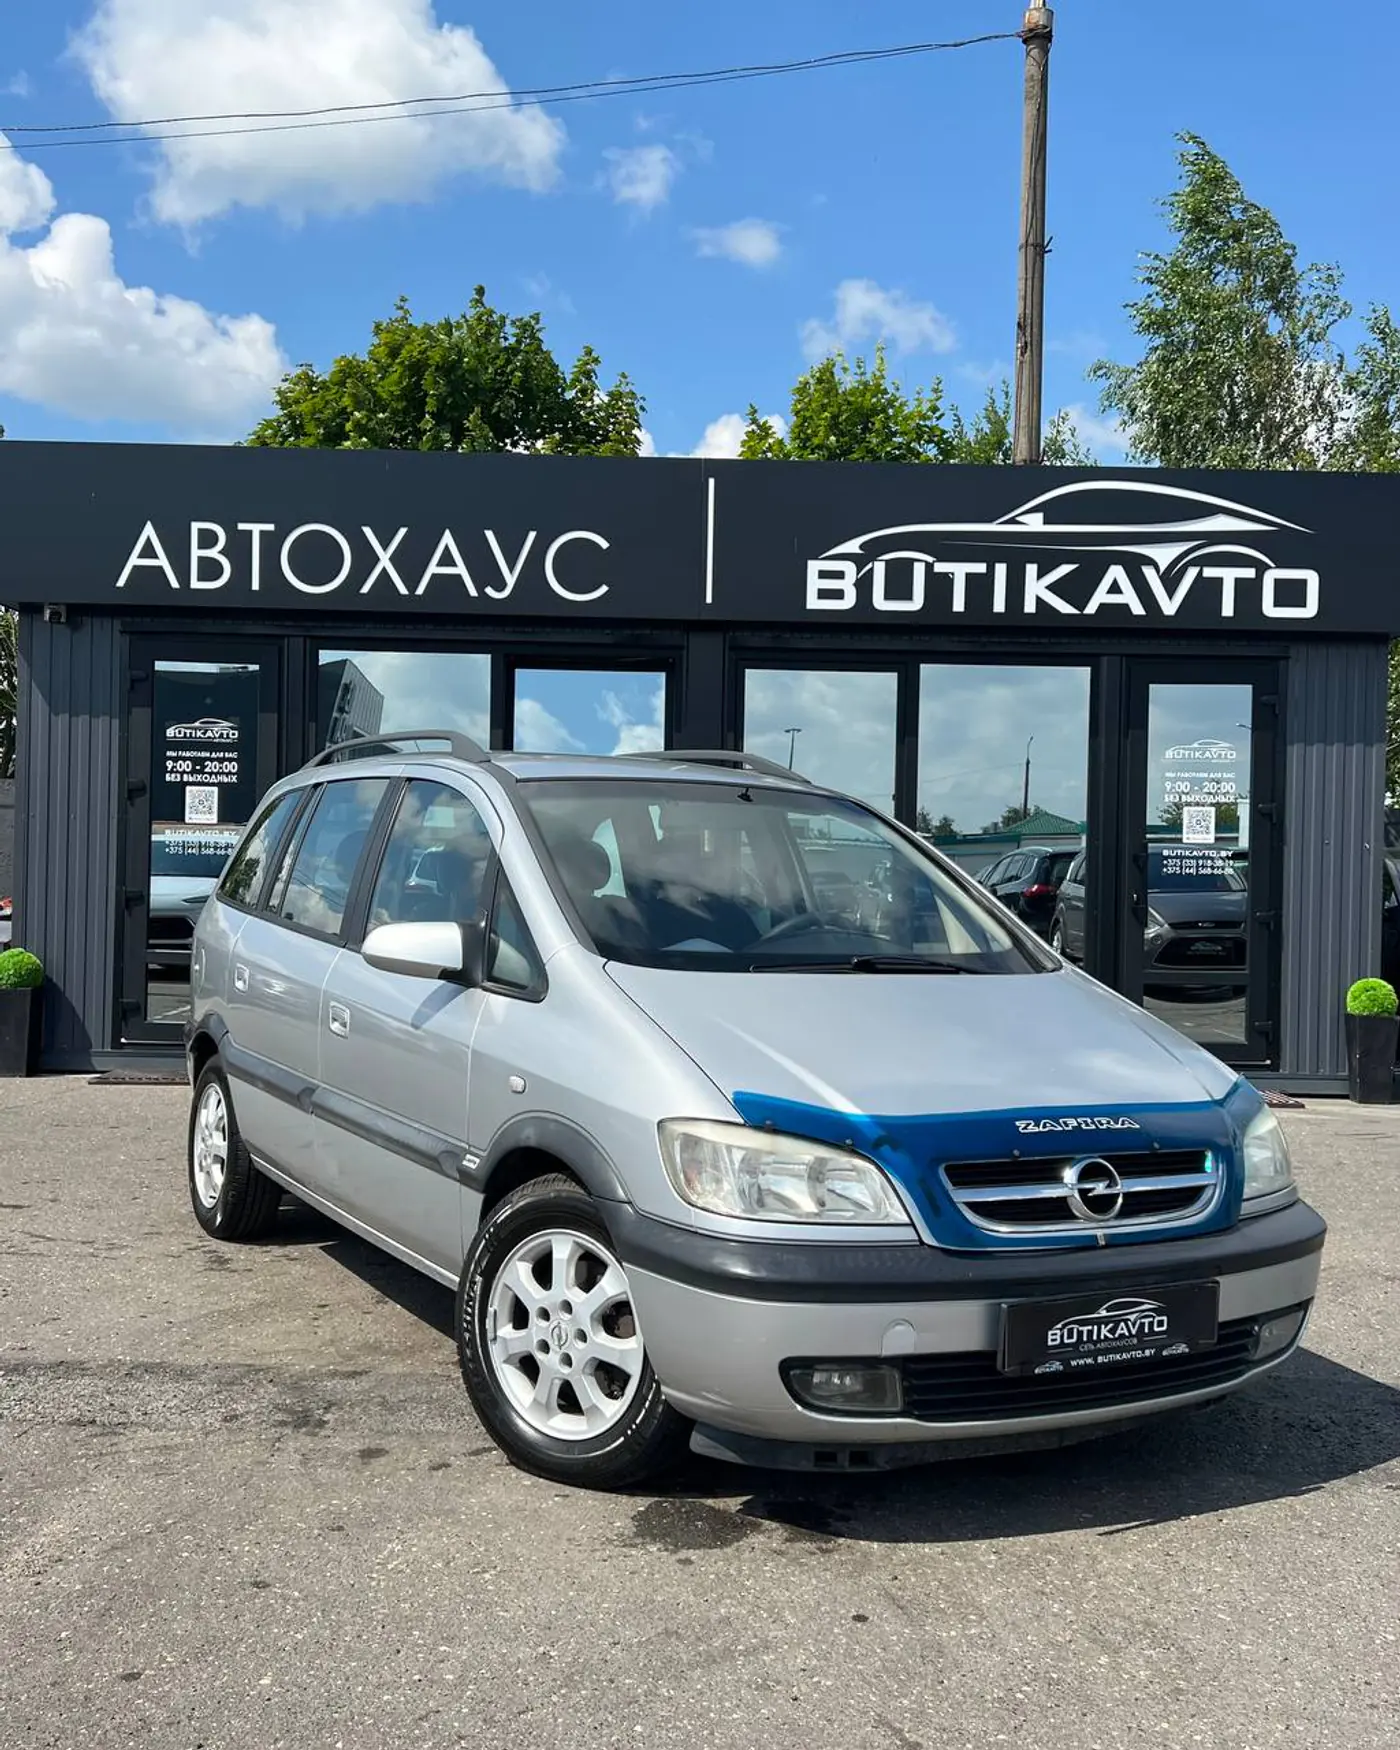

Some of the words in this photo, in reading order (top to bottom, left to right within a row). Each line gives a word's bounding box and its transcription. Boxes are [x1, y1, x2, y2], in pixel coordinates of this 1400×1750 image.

[115, 519, 611, 601] АВТОХАУС
[805, 559, 1320, 619] BUTIKAVTO
[165, 728, 239, 739] BUTIKAVTO
[1164, 749, 1236, 758] BUTIKAVTO
[165, 760, 192, 772] 9:00
[203, 761, 238, 773] 20:00
[165, 773, 181, 782] БЕЗ
[182, 773, 238, 784] ВЫХОДНЫХ
[1164, 781, 1191, 793] 9:00
[1202, 781, 1236, 793] 20:00
[1162, 849, 1234, 857] BUTIKAVTO.BY
[1015, 1117, 1141, 1133] ZAFIRA
[1047, 1316, 1168, 1346] BUTIKAVTO
